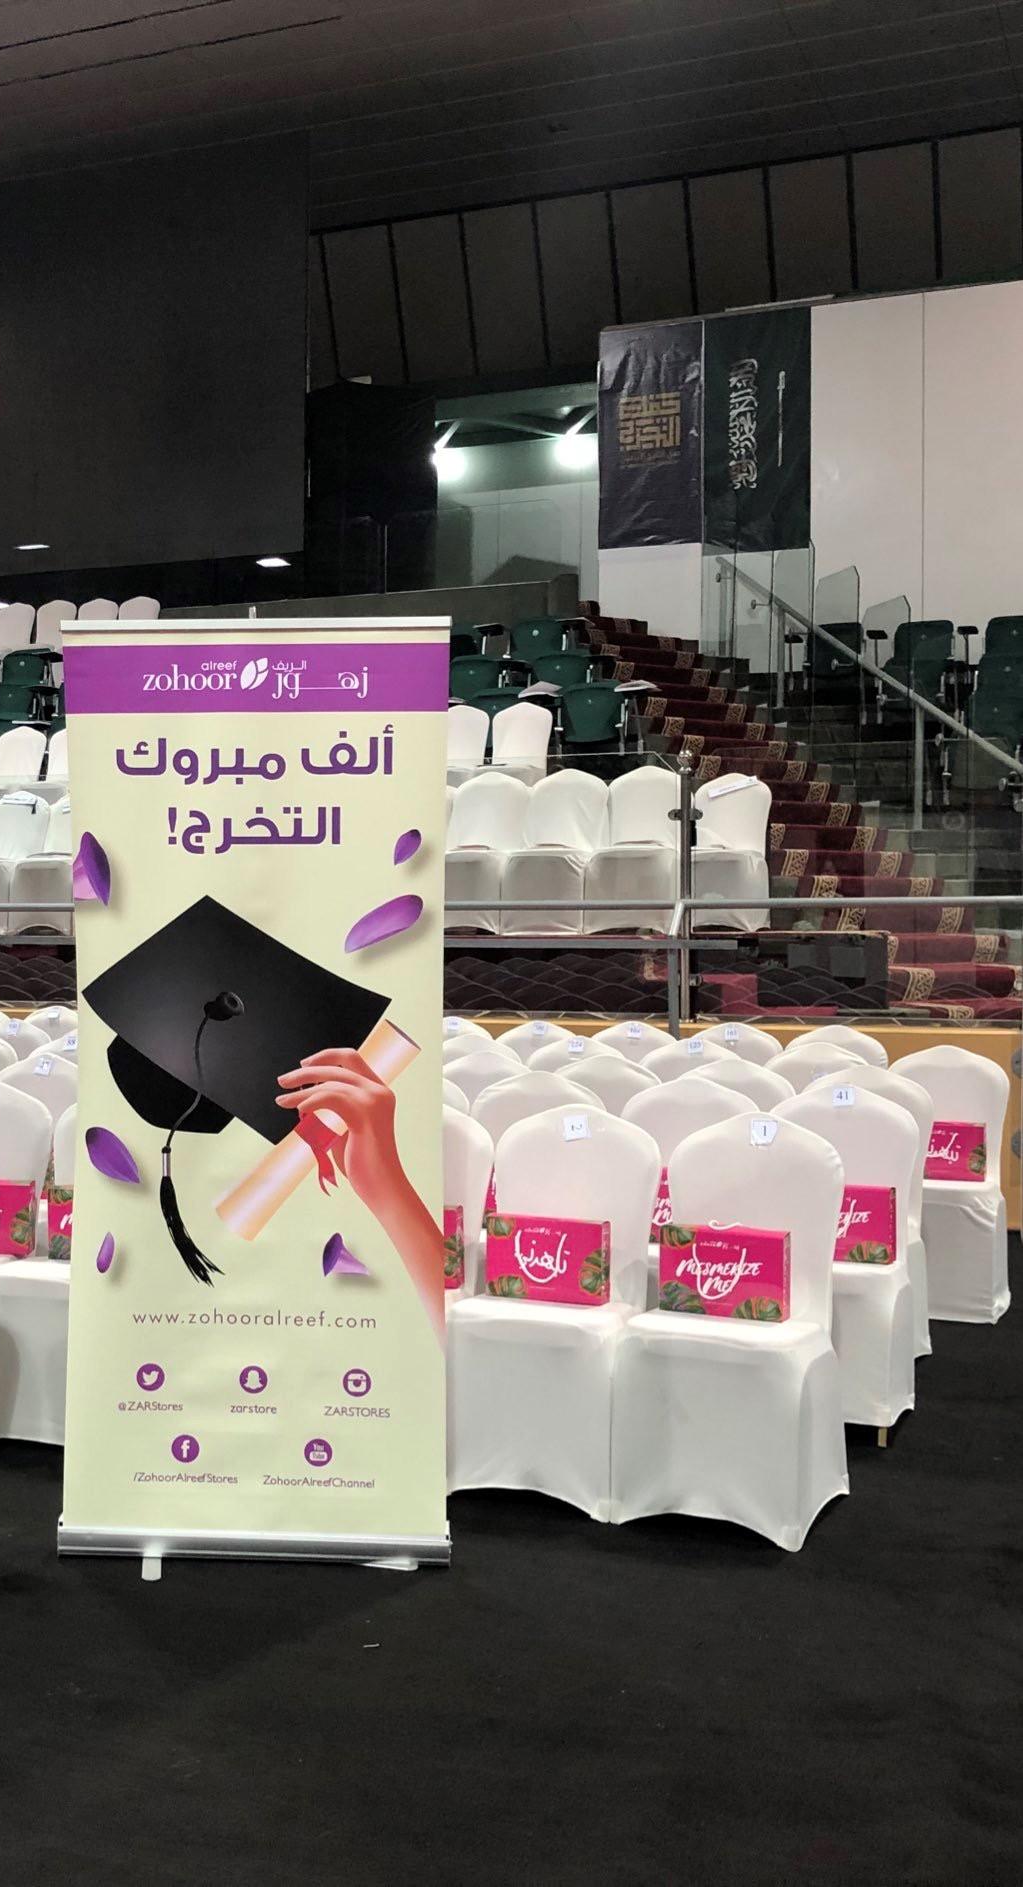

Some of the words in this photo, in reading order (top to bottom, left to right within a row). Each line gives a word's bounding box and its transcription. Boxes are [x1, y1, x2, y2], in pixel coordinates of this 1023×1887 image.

[201, 659, 238, 672] alreef
[142, 664, 238, 692] zohoor
[301, 724, 395, 775] ألف
[115, 737, 286, 785] مبروك
[167, 806, 341, 855] التخرج!
[836, 1090, 849, 1101] 41
[132, 1308, 378, 1329] www.zohooralreef.com
[118, 1400, 184, 1412] @ZARStores
[230, 1403, 277, 1415] zarstore
[324, 1406, 391, 1418] ZARSTORES
[132, 1471, 239, 1485] /ZohoorAlreefStores
[262, 1474, 376, 1489] ZohoorAlreefChannel
